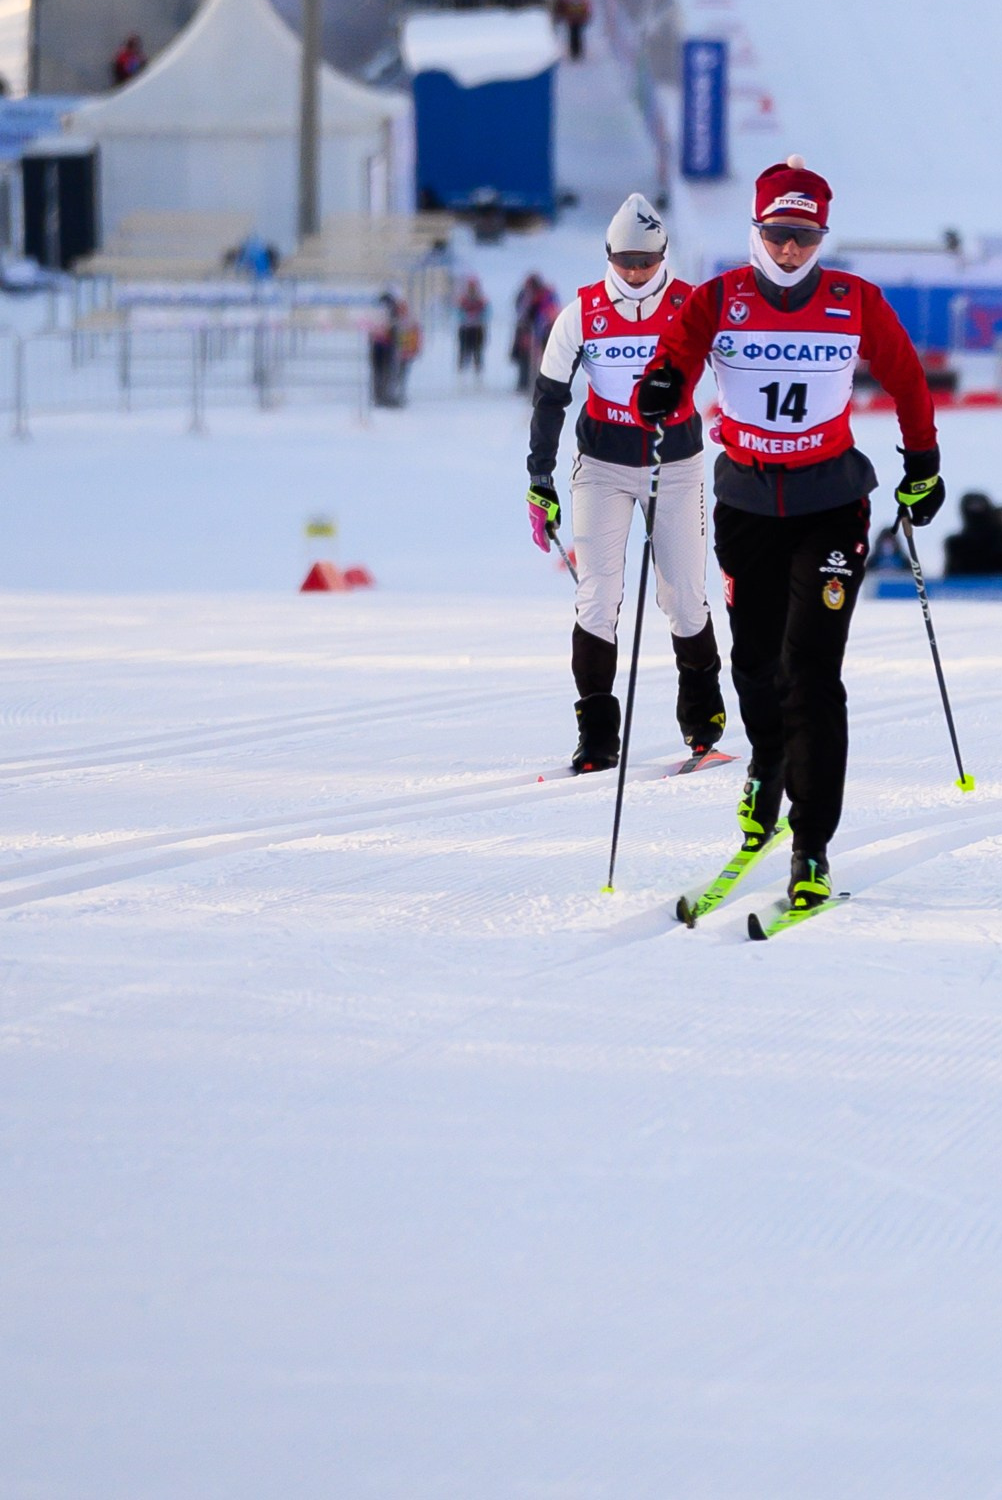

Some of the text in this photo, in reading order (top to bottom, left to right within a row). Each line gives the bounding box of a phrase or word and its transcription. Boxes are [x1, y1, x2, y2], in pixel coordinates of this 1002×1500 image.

[605, 345, 657, 359] ФОСА
[743, 343, 853, 362] ФОСАГРО
[759, 381, 808, 423] 14
[738, 430, 824, 455] ИЖЕВСК
